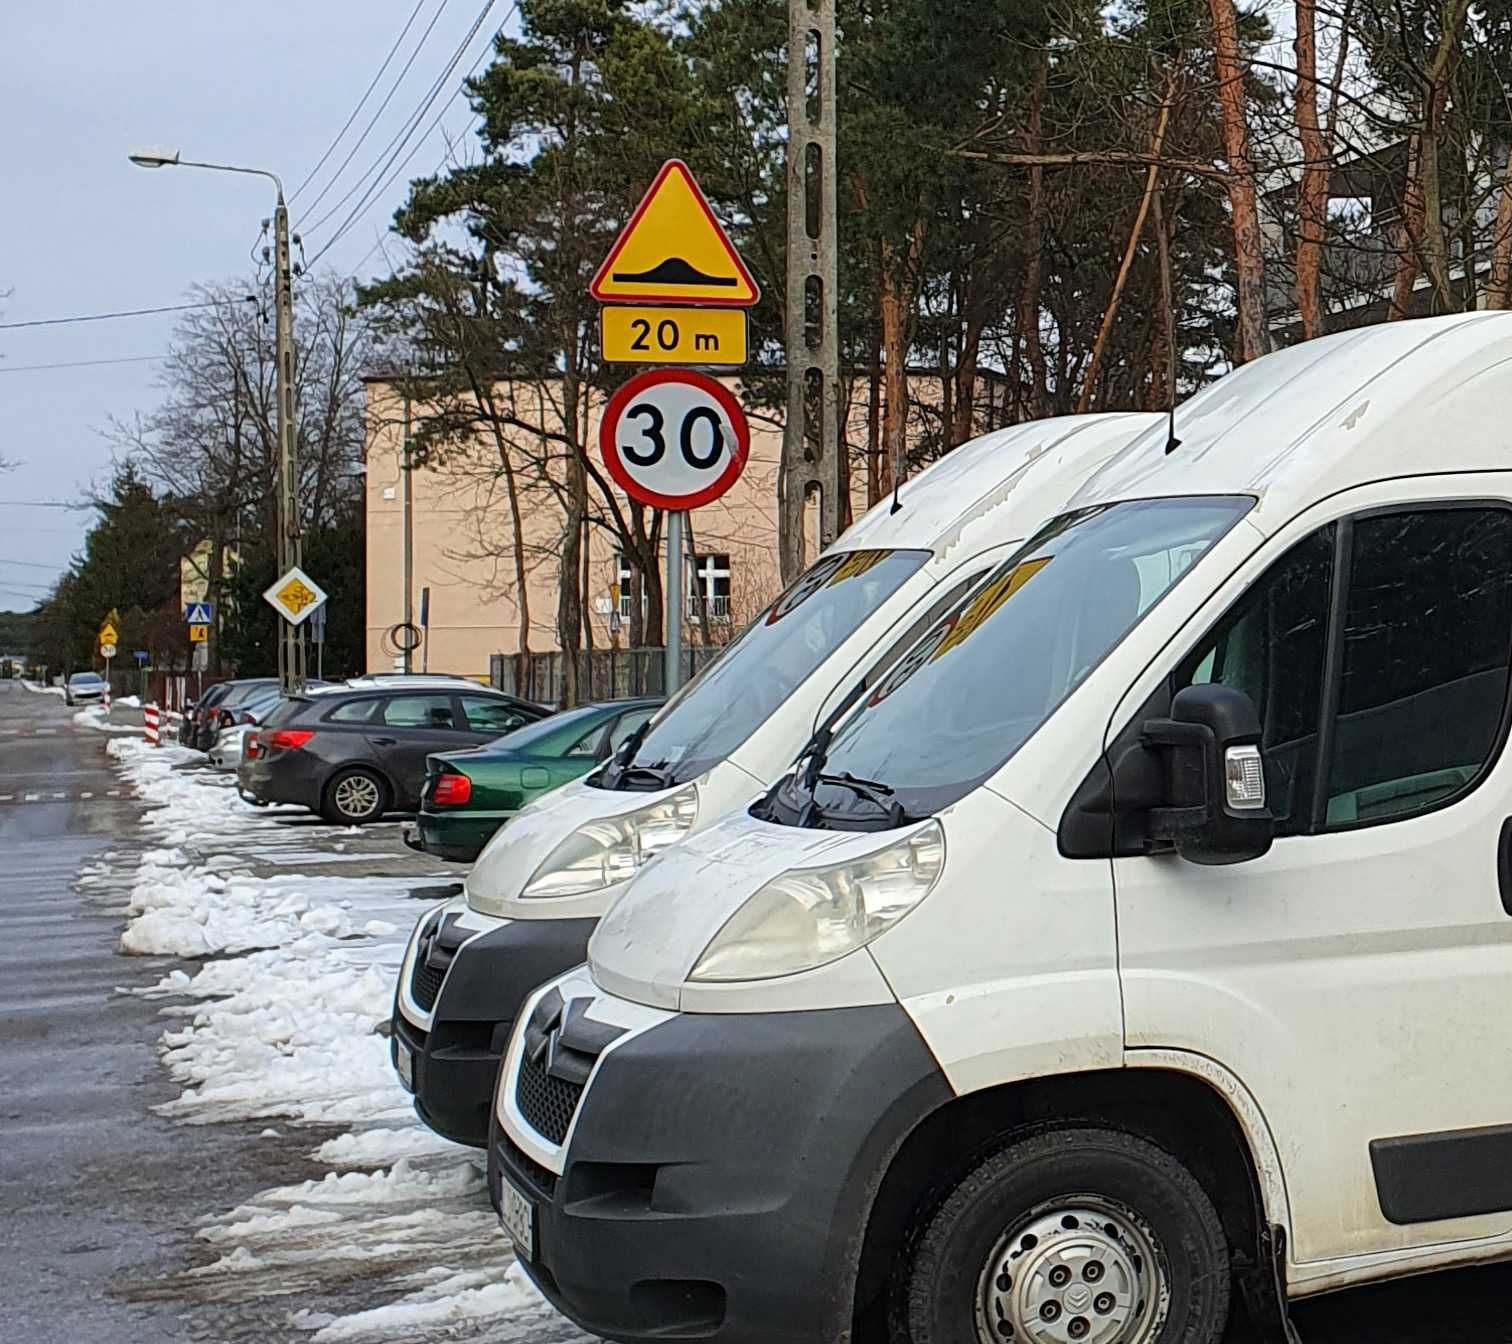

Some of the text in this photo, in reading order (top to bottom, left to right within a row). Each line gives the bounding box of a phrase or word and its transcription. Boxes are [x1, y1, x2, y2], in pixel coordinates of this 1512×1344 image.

[631, 318, 719, 351] 20 m
[622, 403, 724, 470] 30
